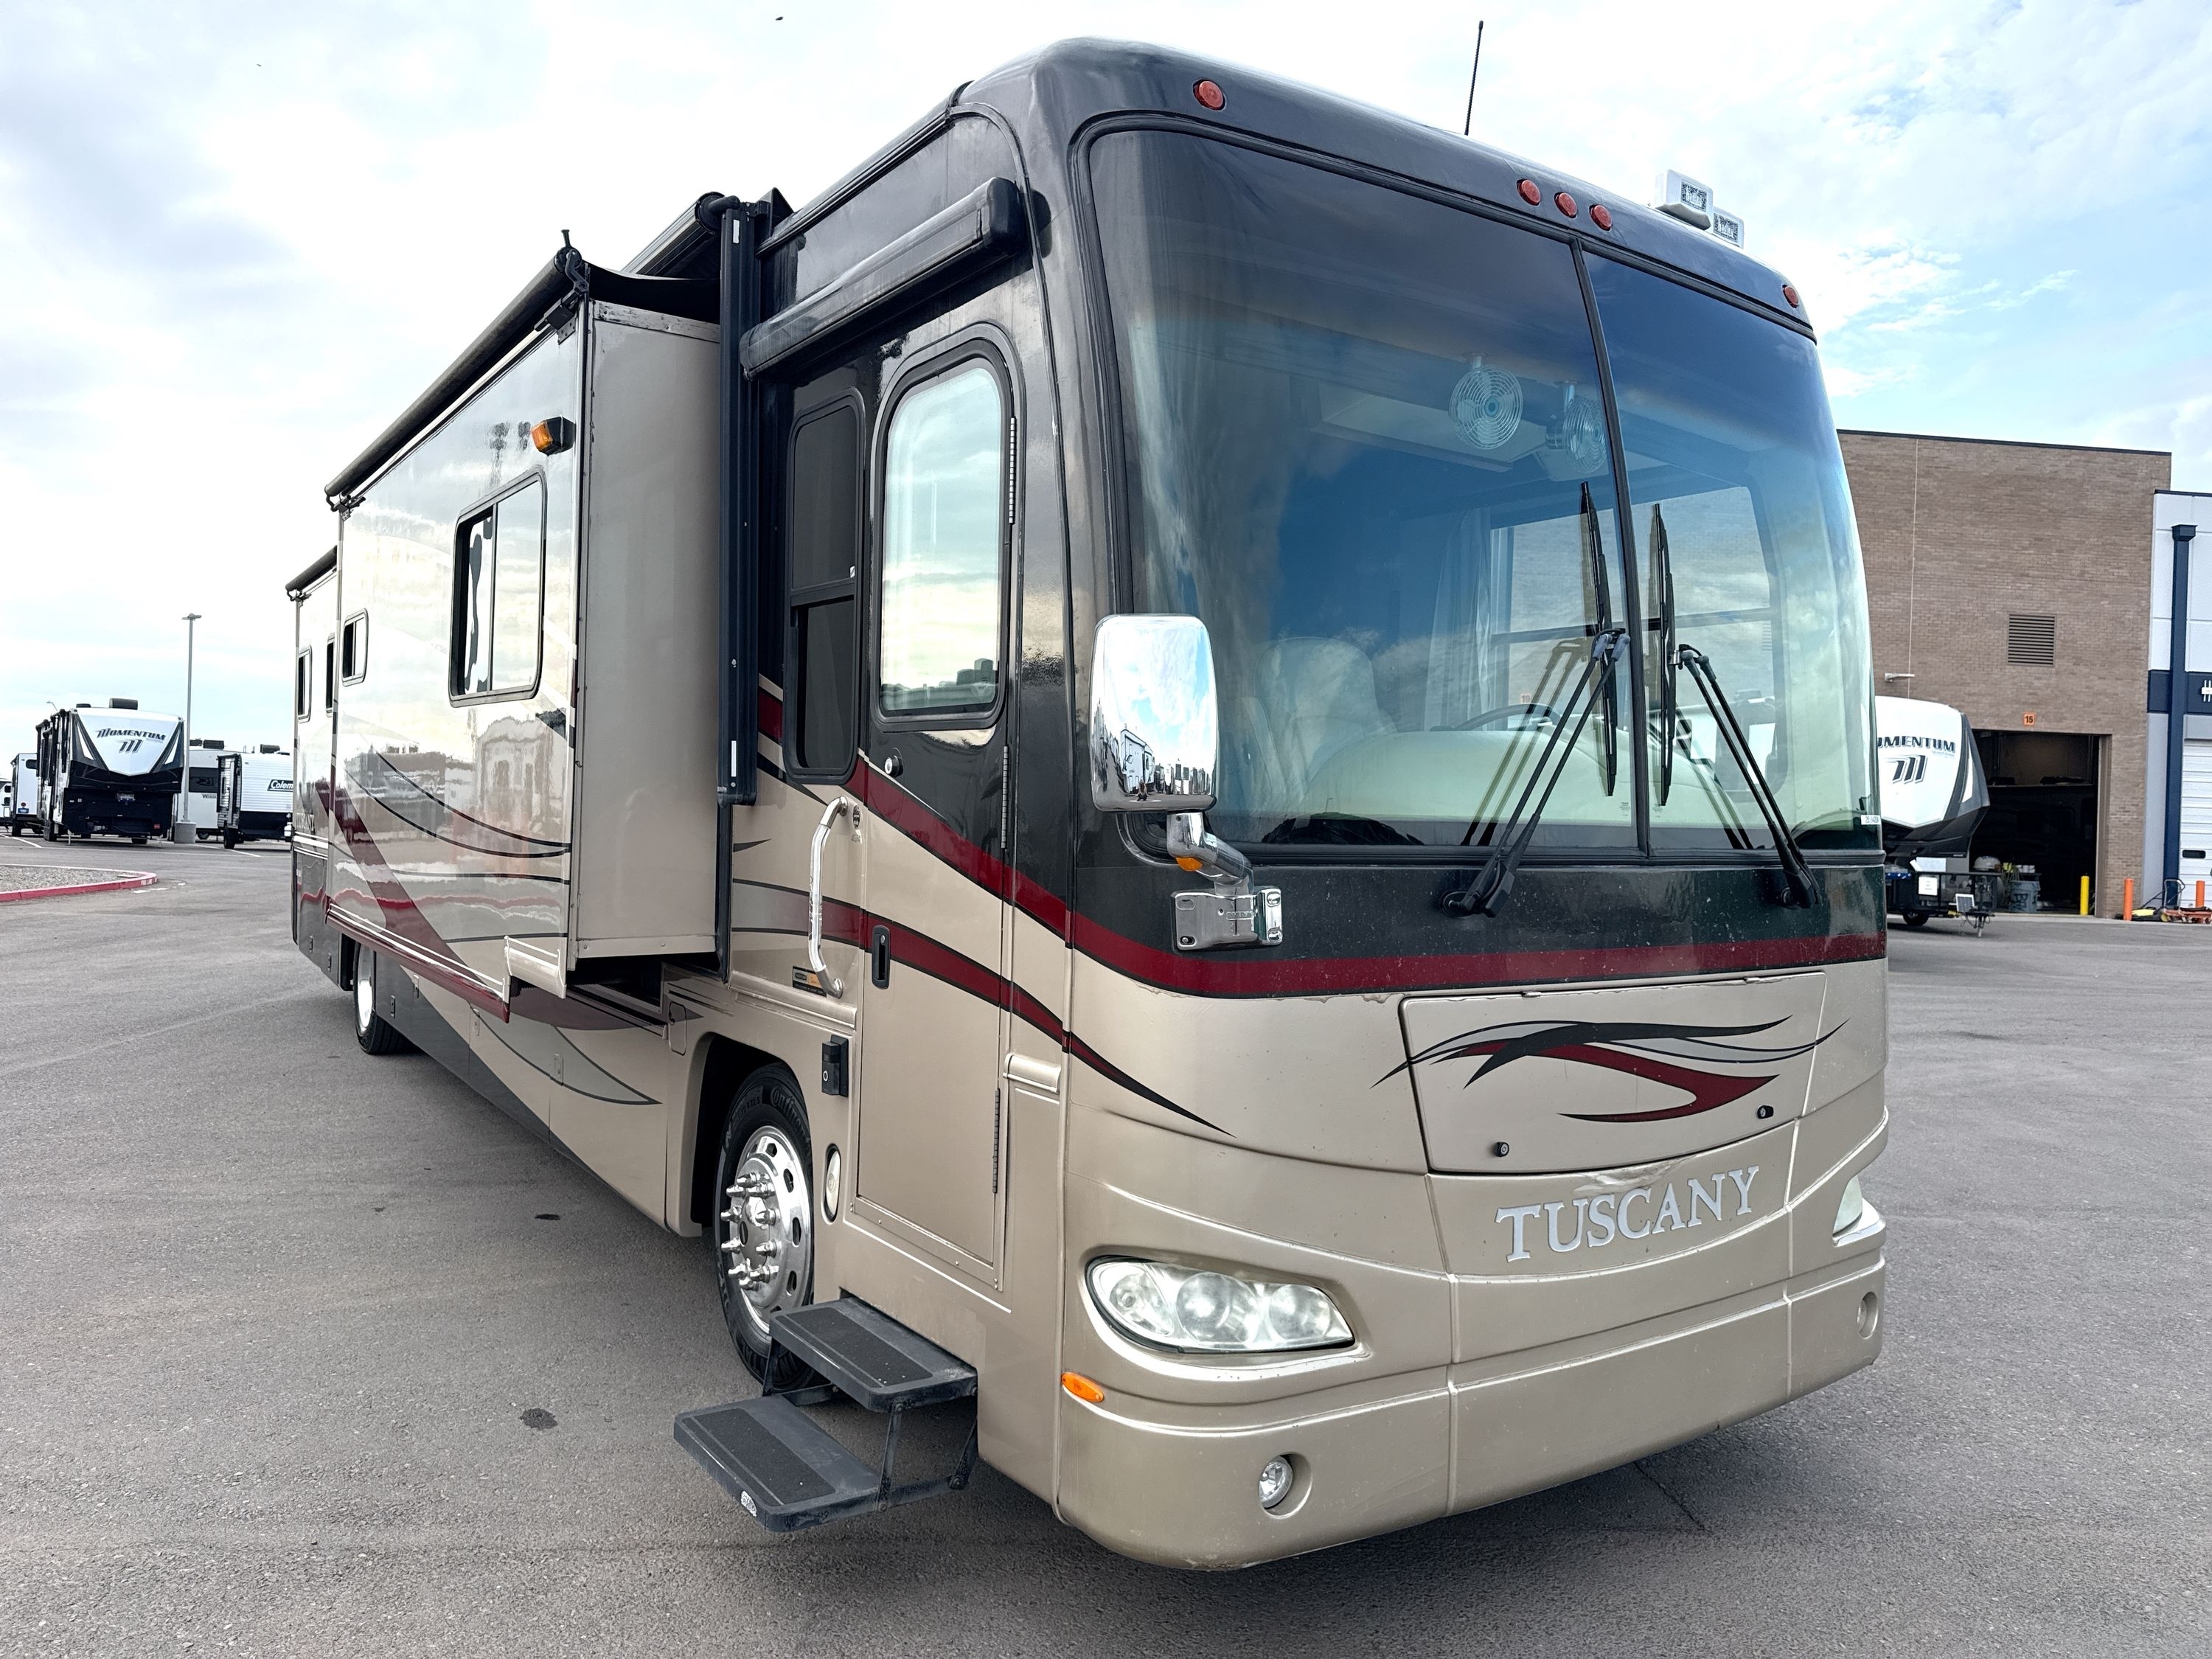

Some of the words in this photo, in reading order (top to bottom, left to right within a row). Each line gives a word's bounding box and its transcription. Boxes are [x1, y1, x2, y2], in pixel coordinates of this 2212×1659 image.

[2025, 715, 2034, 723] 15
[96, 728, 166, 741] MOMENTUM
[1877, 736, 1955, 753] MENTUM
[271, 780, 293, 790] Colem
[1495, 1165, 1760, 1263] TUSCANY
